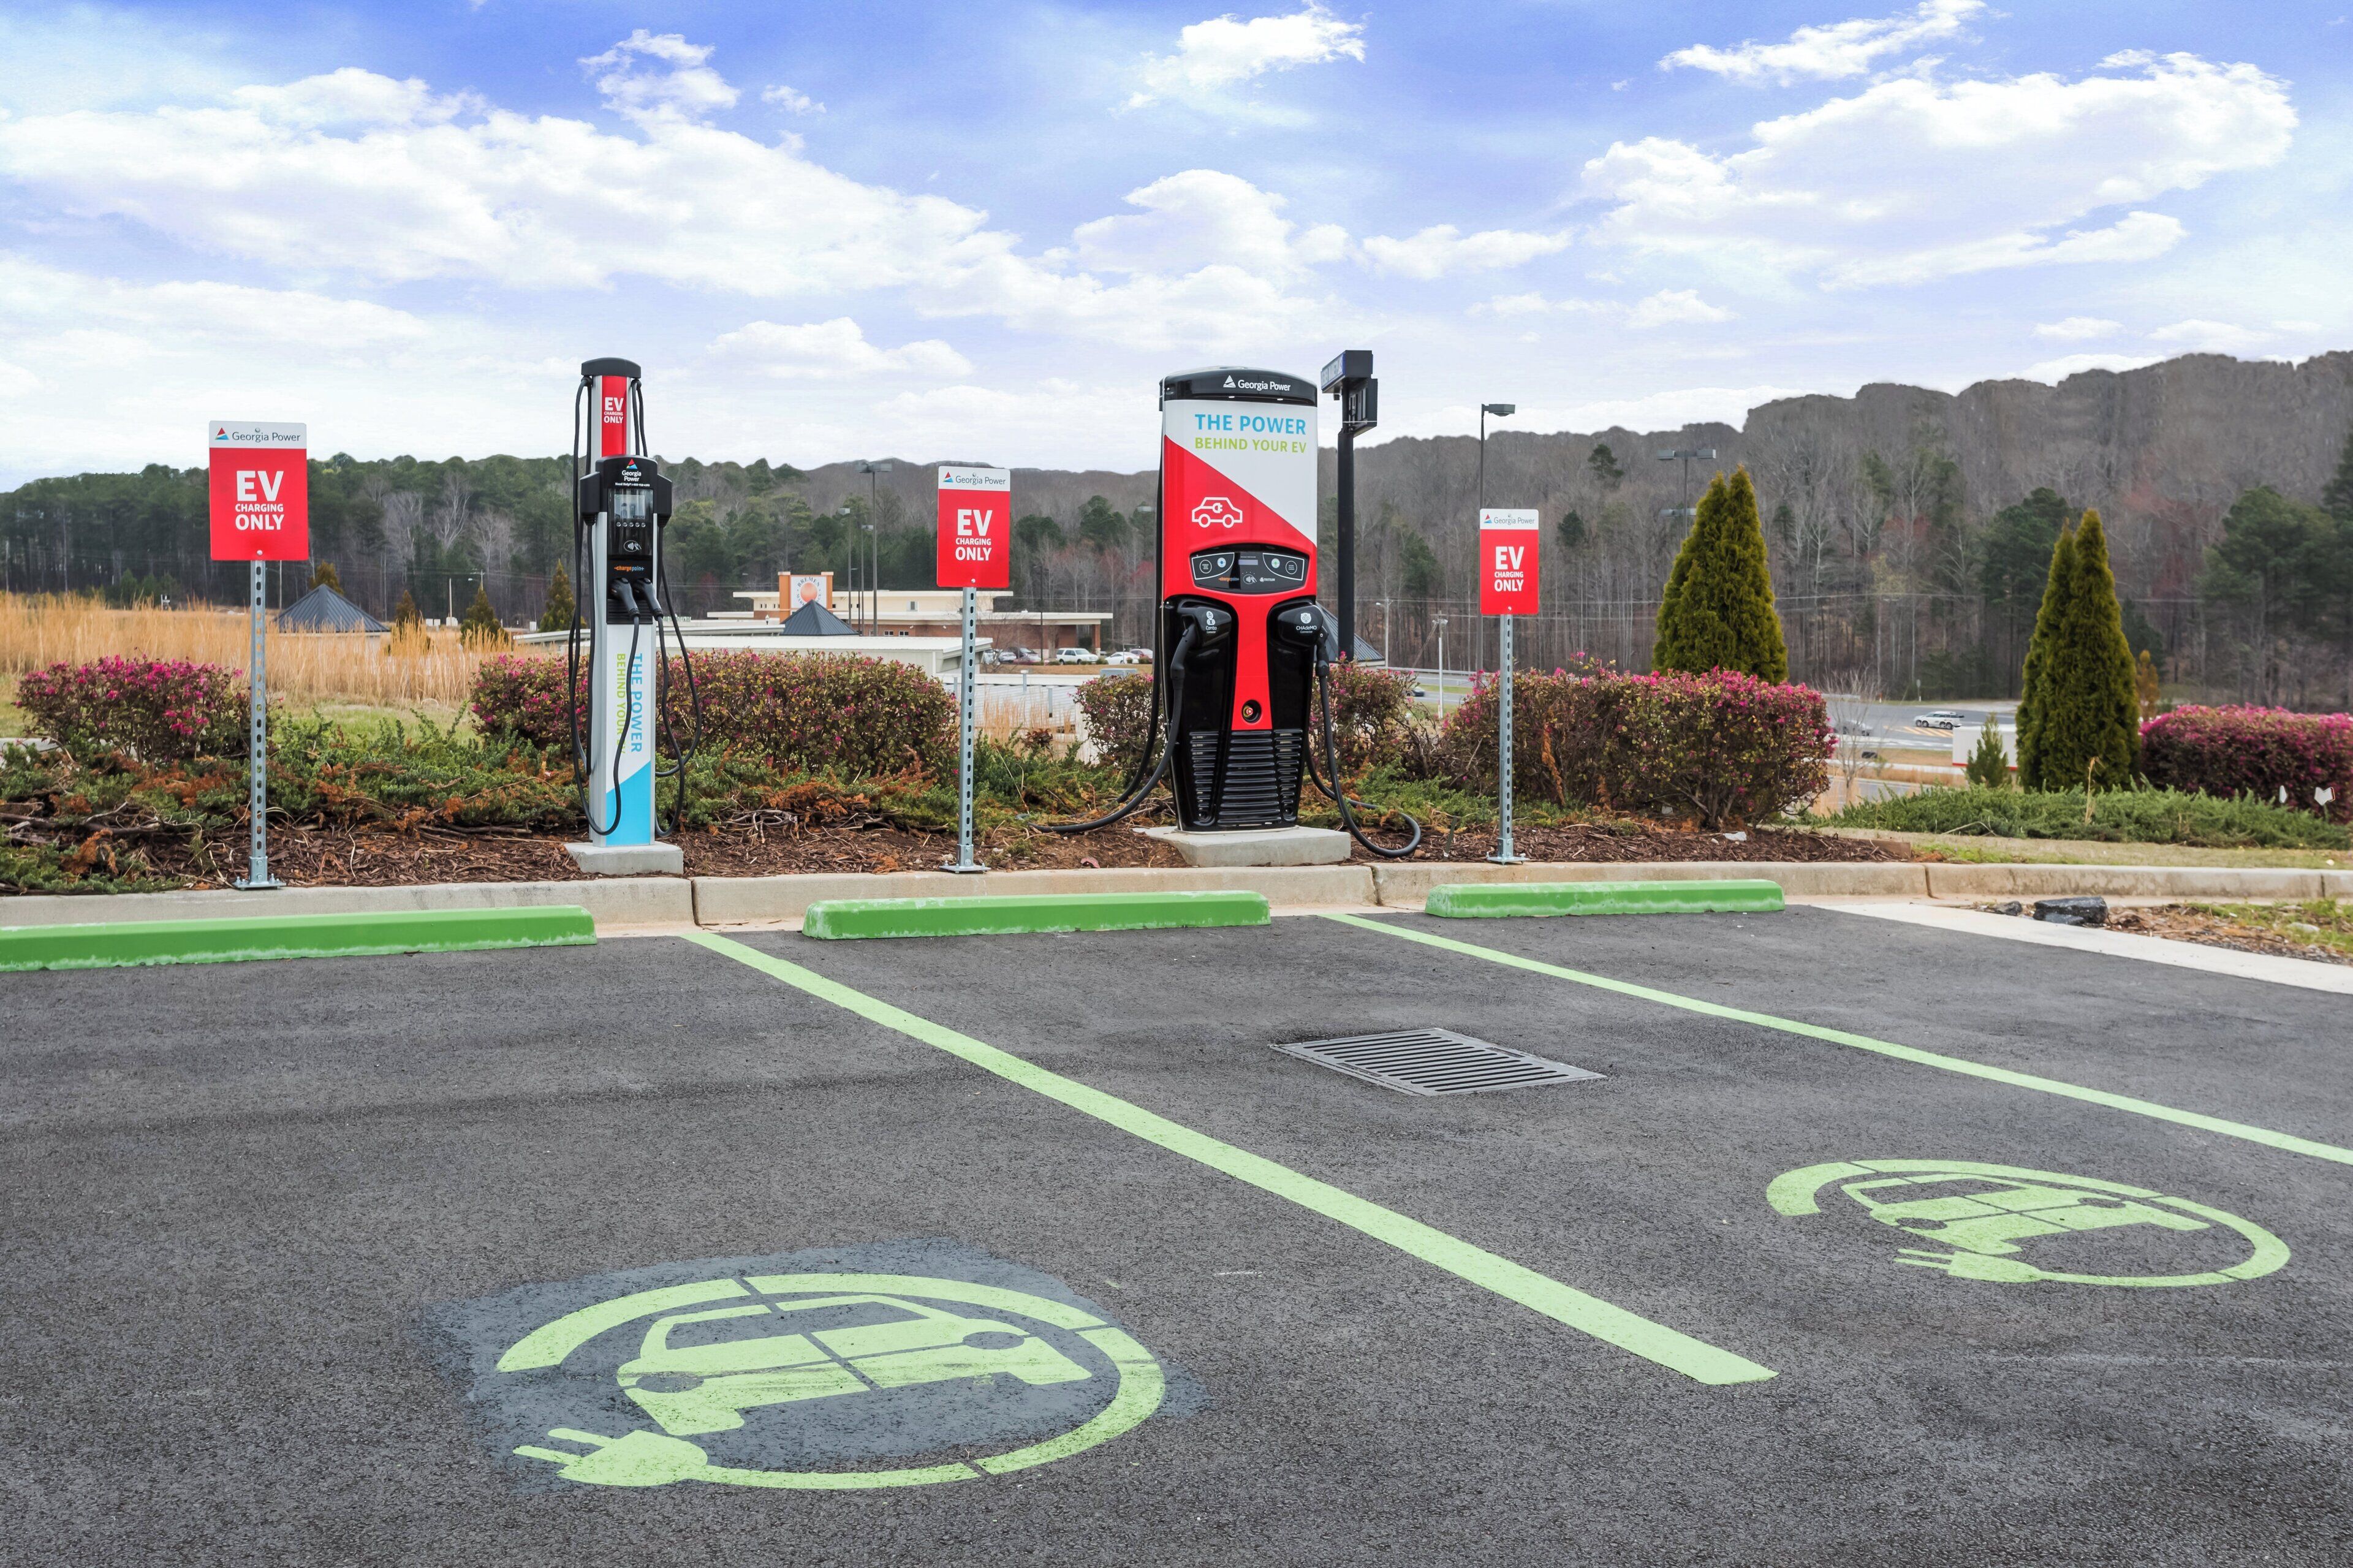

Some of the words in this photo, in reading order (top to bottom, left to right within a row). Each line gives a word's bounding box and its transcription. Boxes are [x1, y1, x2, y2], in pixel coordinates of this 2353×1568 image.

[1238, 379, 1268, 391] Georgia
[1270, 381, 1291, 391] Power
[605, 397, 624, 411] EV
[1195, 414, 1233, 431] THE
[1240, 415, 1306, 435] POWER
[232, 431, 269, 443] Georgia
[272, 432, 300, 441] Power
[1195, 437, 1248, 450] BEHIND
[1252, 439, 1287, 452] YOUR
[1292, 442, 1306, 453] EV
[237, 471, 284, 501] EV
[955, 475, 983, 485] Georgia
[235, 504, 284, 512] CHARGING
[235, 514, 284, 531] ONLY
[957, 509, 993, 536] EV
[955, 547, 992, 561] ONLY
[1495, 546, 1525, 570] EV
[1494, 579, 1524, 592] ONLY
[616, 653, 626, 699] BEHIND
[631, 653, 642, 685] THE
[616, 702, 626, 735] YOUR
[631, 691, 642, 752] POWER
